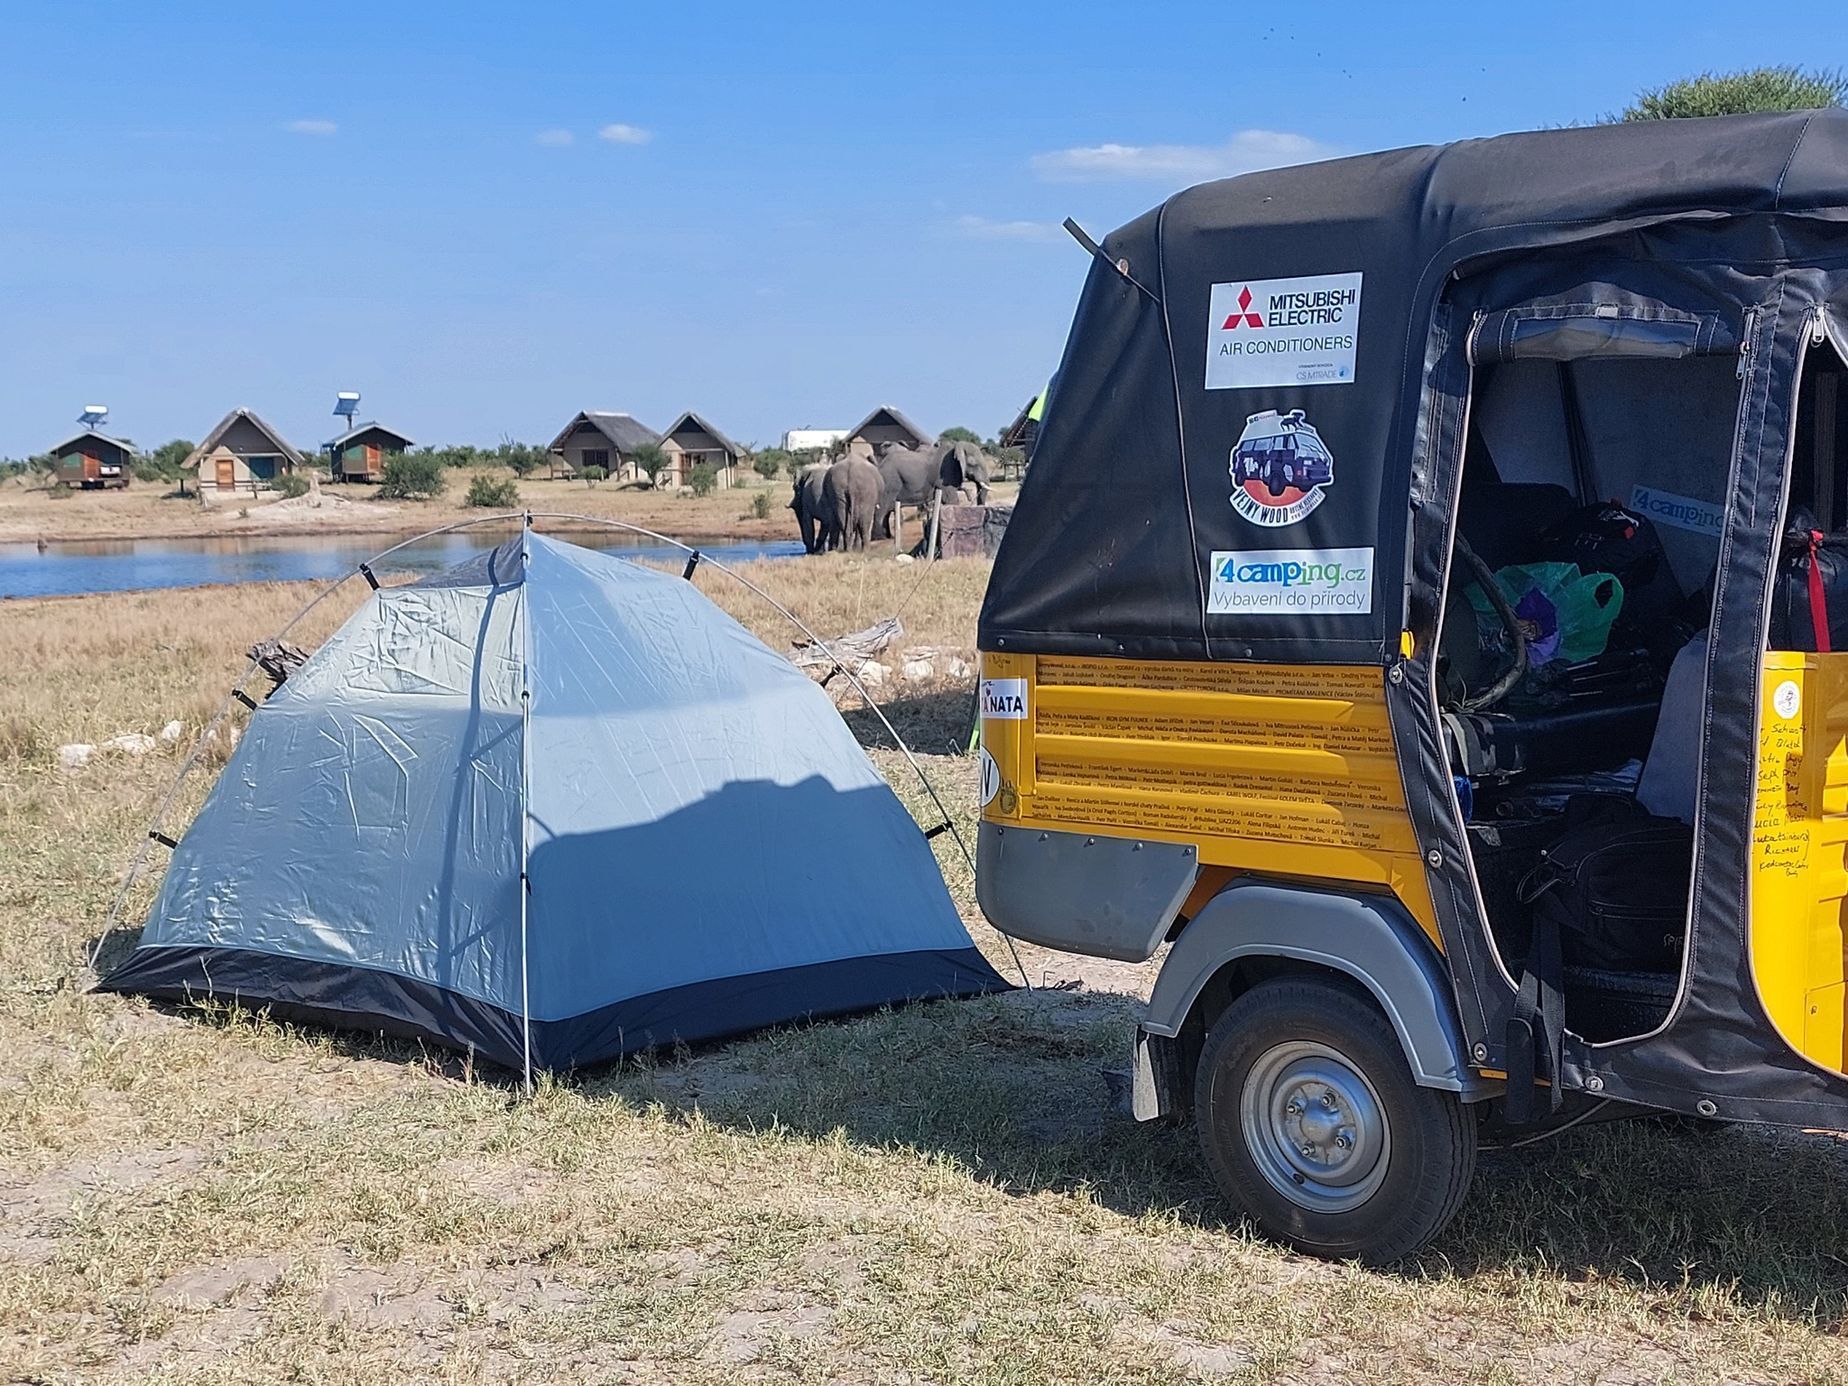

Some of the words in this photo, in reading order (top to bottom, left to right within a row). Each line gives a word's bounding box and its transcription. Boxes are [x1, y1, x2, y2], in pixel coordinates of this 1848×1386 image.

[1269, 289, 1356, 310] MITSUBISHI
[1268, 307, 1343, 327] ELECTRIC
[1219, 342, 1243, 356] AIR
[1246, 335, 1353, 355] CONDITIONERS
[1260, 506, 1289, 523] WOOD
[1216, 558, 1366, 588] 4camping.cz
[1214, 591, 1282, 609] Vybavení
[1286, 591, 1307, 606] do
[1311, 590, 1366, 609] přírody
